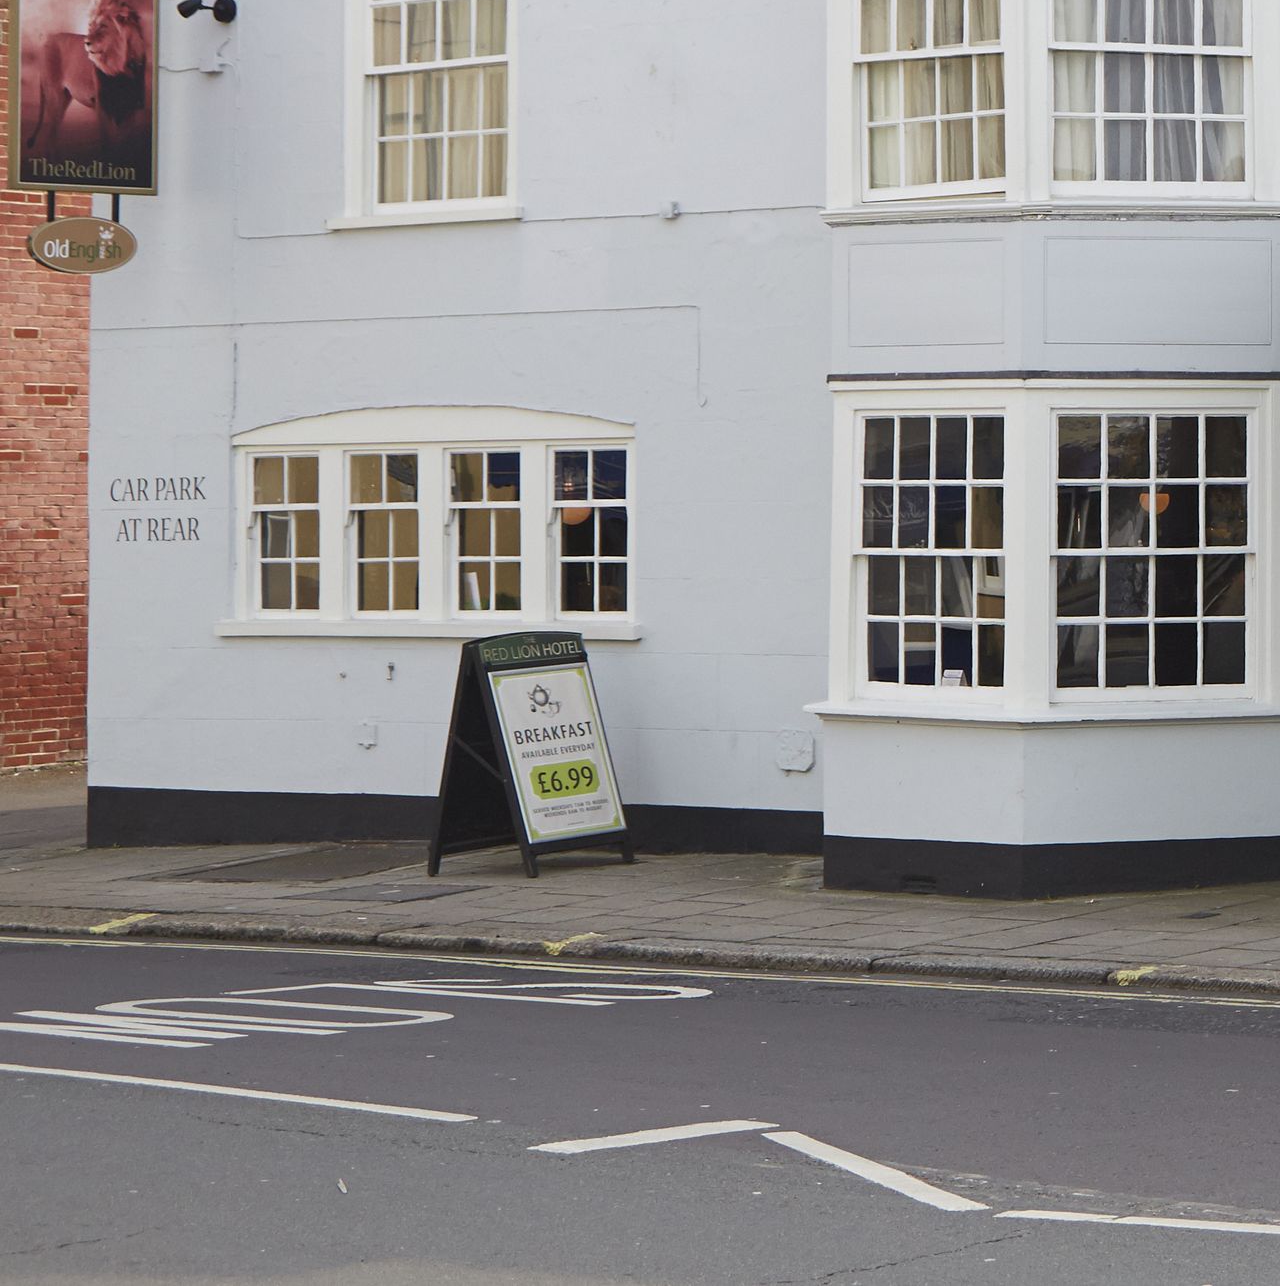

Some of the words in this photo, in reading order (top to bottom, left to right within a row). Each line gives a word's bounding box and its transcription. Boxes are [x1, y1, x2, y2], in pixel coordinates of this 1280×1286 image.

[110, 477, 149, 502] CAR
[155, 476, 207, 501] PARK
[116, 518, 142, 542] AT
[147, 517, 200, 542] REAR
[483, 647, 509, 662] RED
[510, 643, 541, 659] LION
[542, 640, 582, 656] HOTEL
[513, 721, 593, 745] BREAKFAST
[521, 747, 559, 759] AVAILABLE
[560, 742, 596, 754] EVERYDAY
[537, 765, 593, 794] £6.99
